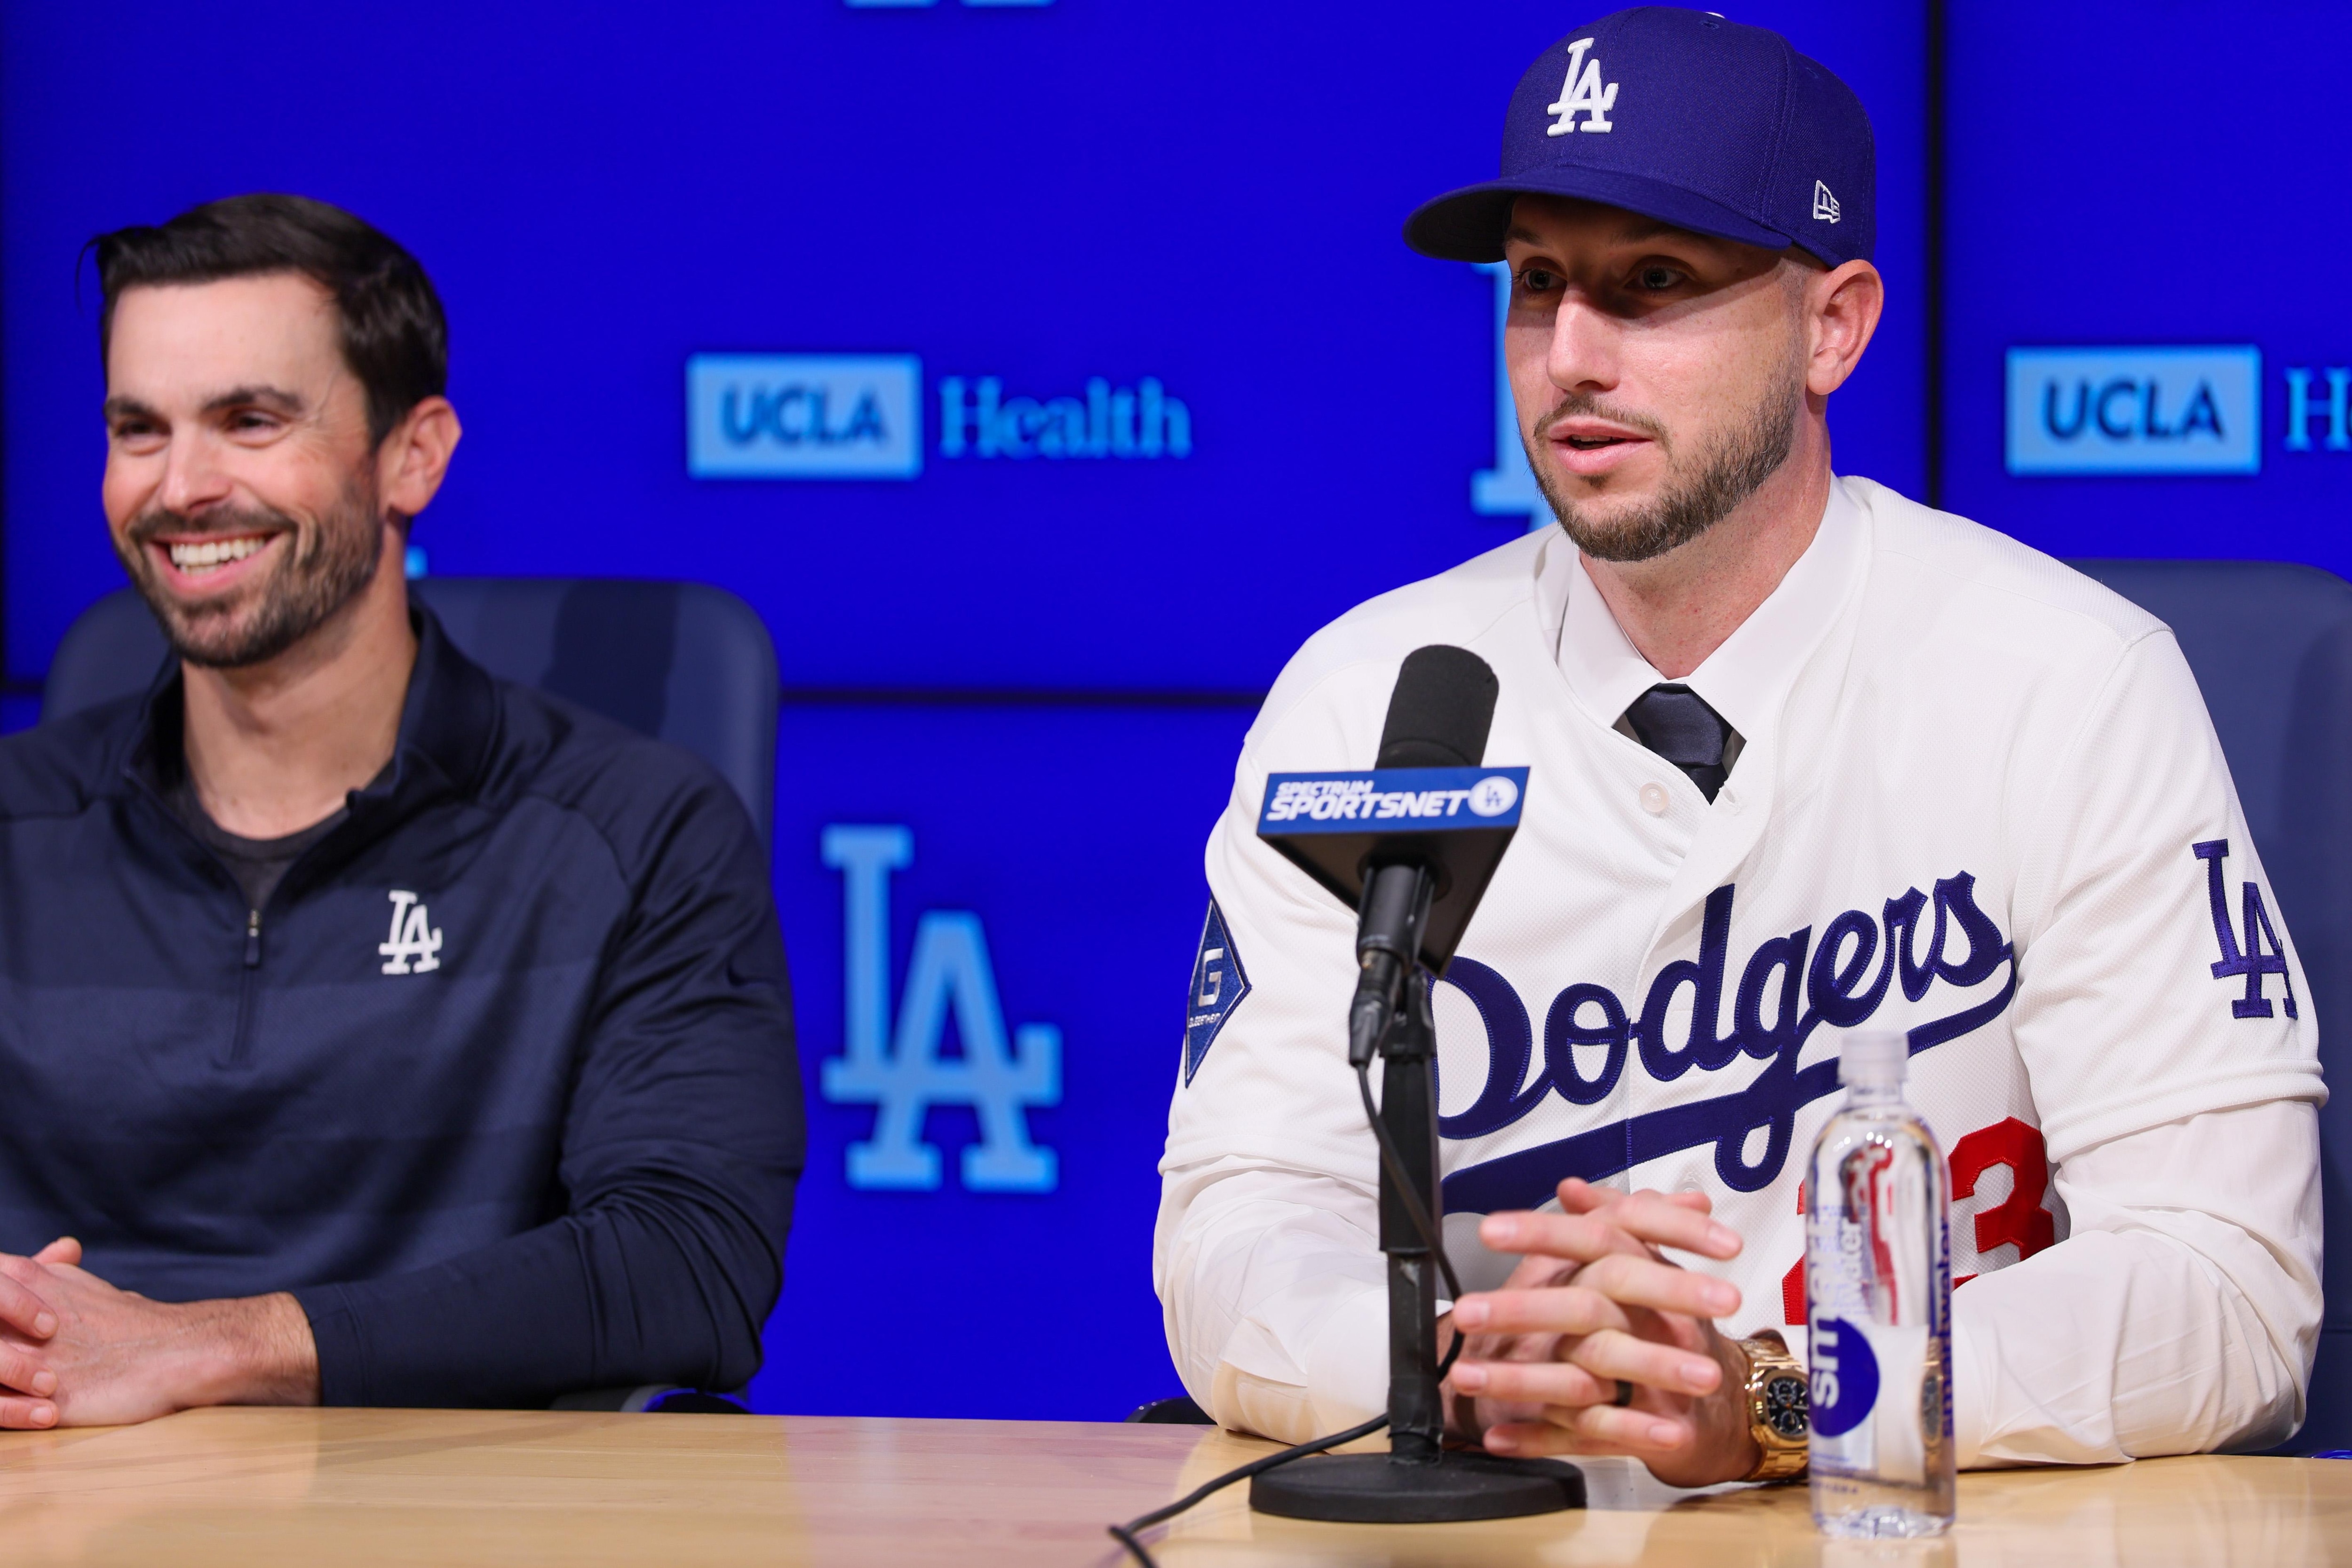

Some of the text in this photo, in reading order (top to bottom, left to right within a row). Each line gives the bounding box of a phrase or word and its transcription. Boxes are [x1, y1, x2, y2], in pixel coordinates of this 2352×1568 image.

[1547, 38, 1619, 137] LA
[720, 375, 1193, 459] UCLA Health
[2045, 366, 2352, 452] UCLA H
[1266, 790, 1471, 821] SPORTSNET
[1276, 779, 1375, 797] SPECTRUM
[378, 889, 443, 975] LA
[2192, 839, 2298, 1020] LA
[820, 823, 1064, 1194] LA
[1198, 948, 1224, 1007] G
[1428, 870, 2015, 1204] Dodgers
